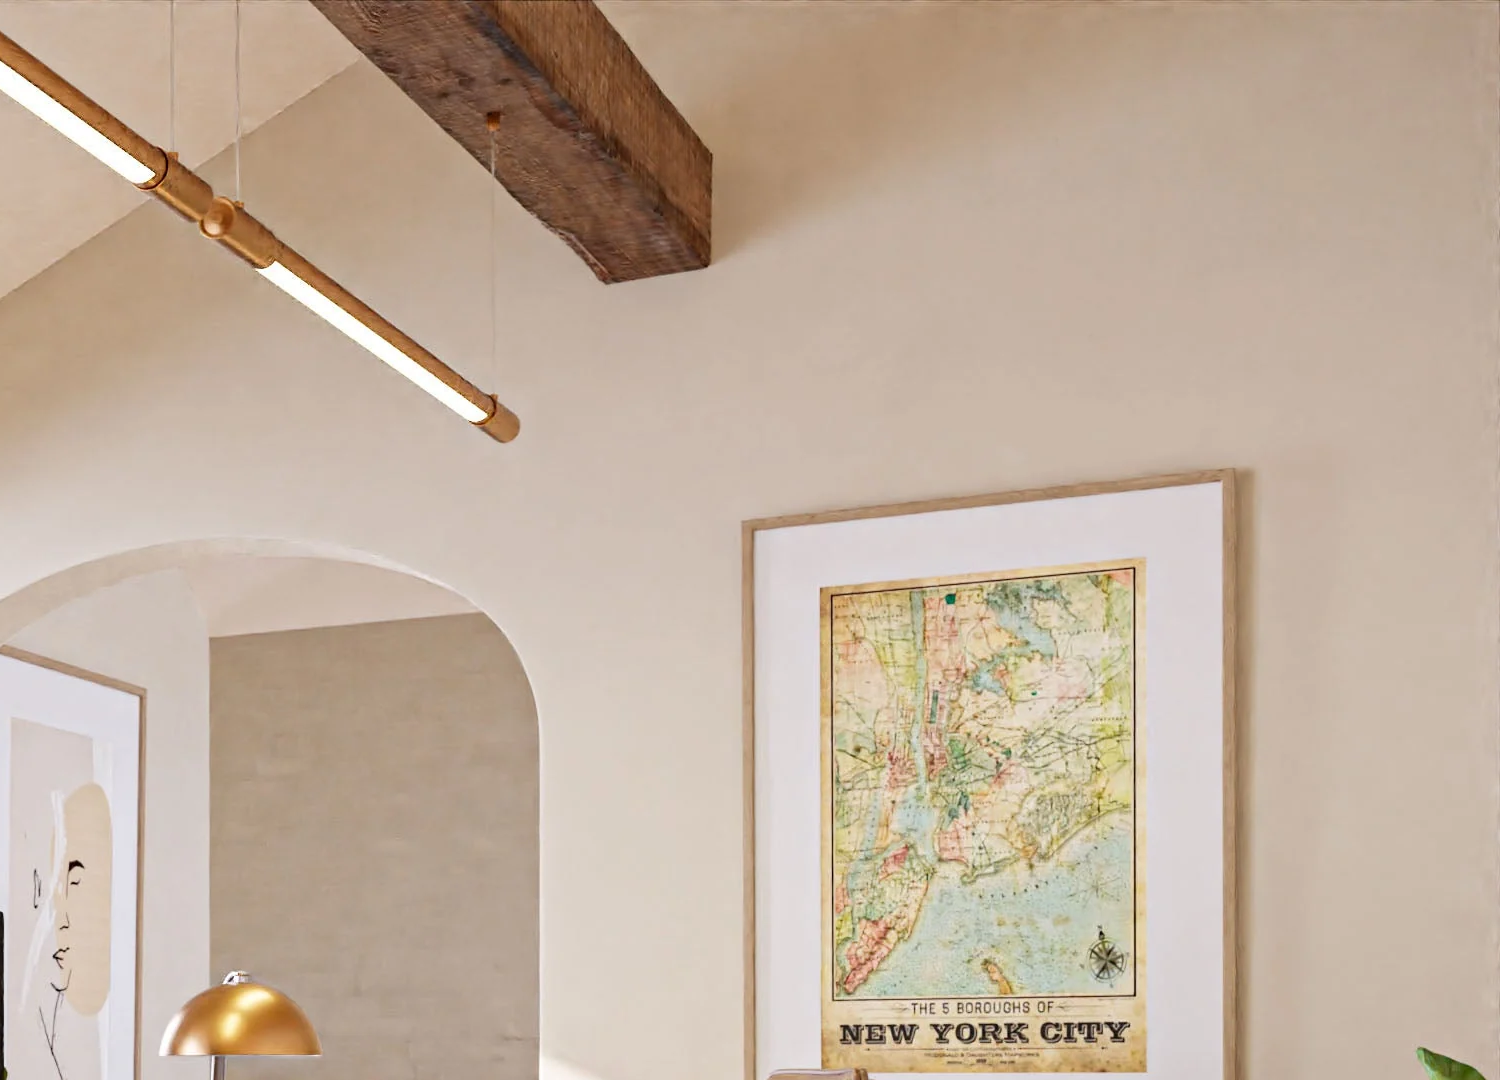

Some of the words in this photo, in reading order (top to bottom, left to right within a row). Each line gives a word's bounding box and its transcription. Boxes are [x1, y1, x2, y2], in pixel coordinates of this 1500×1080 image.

[911, 1002, 936, 1015] THE
[942, 1002, 950, 1015] 5
[957, 1001, 1030, 1014] BOROUGHS
[1037, 1000, 1054, 1013] OF
[839, 1023, 920, 1044] NEW
[929, 1022, 1029, 1044] YORK
[1040, 1021, 1131, 1043] CITY
